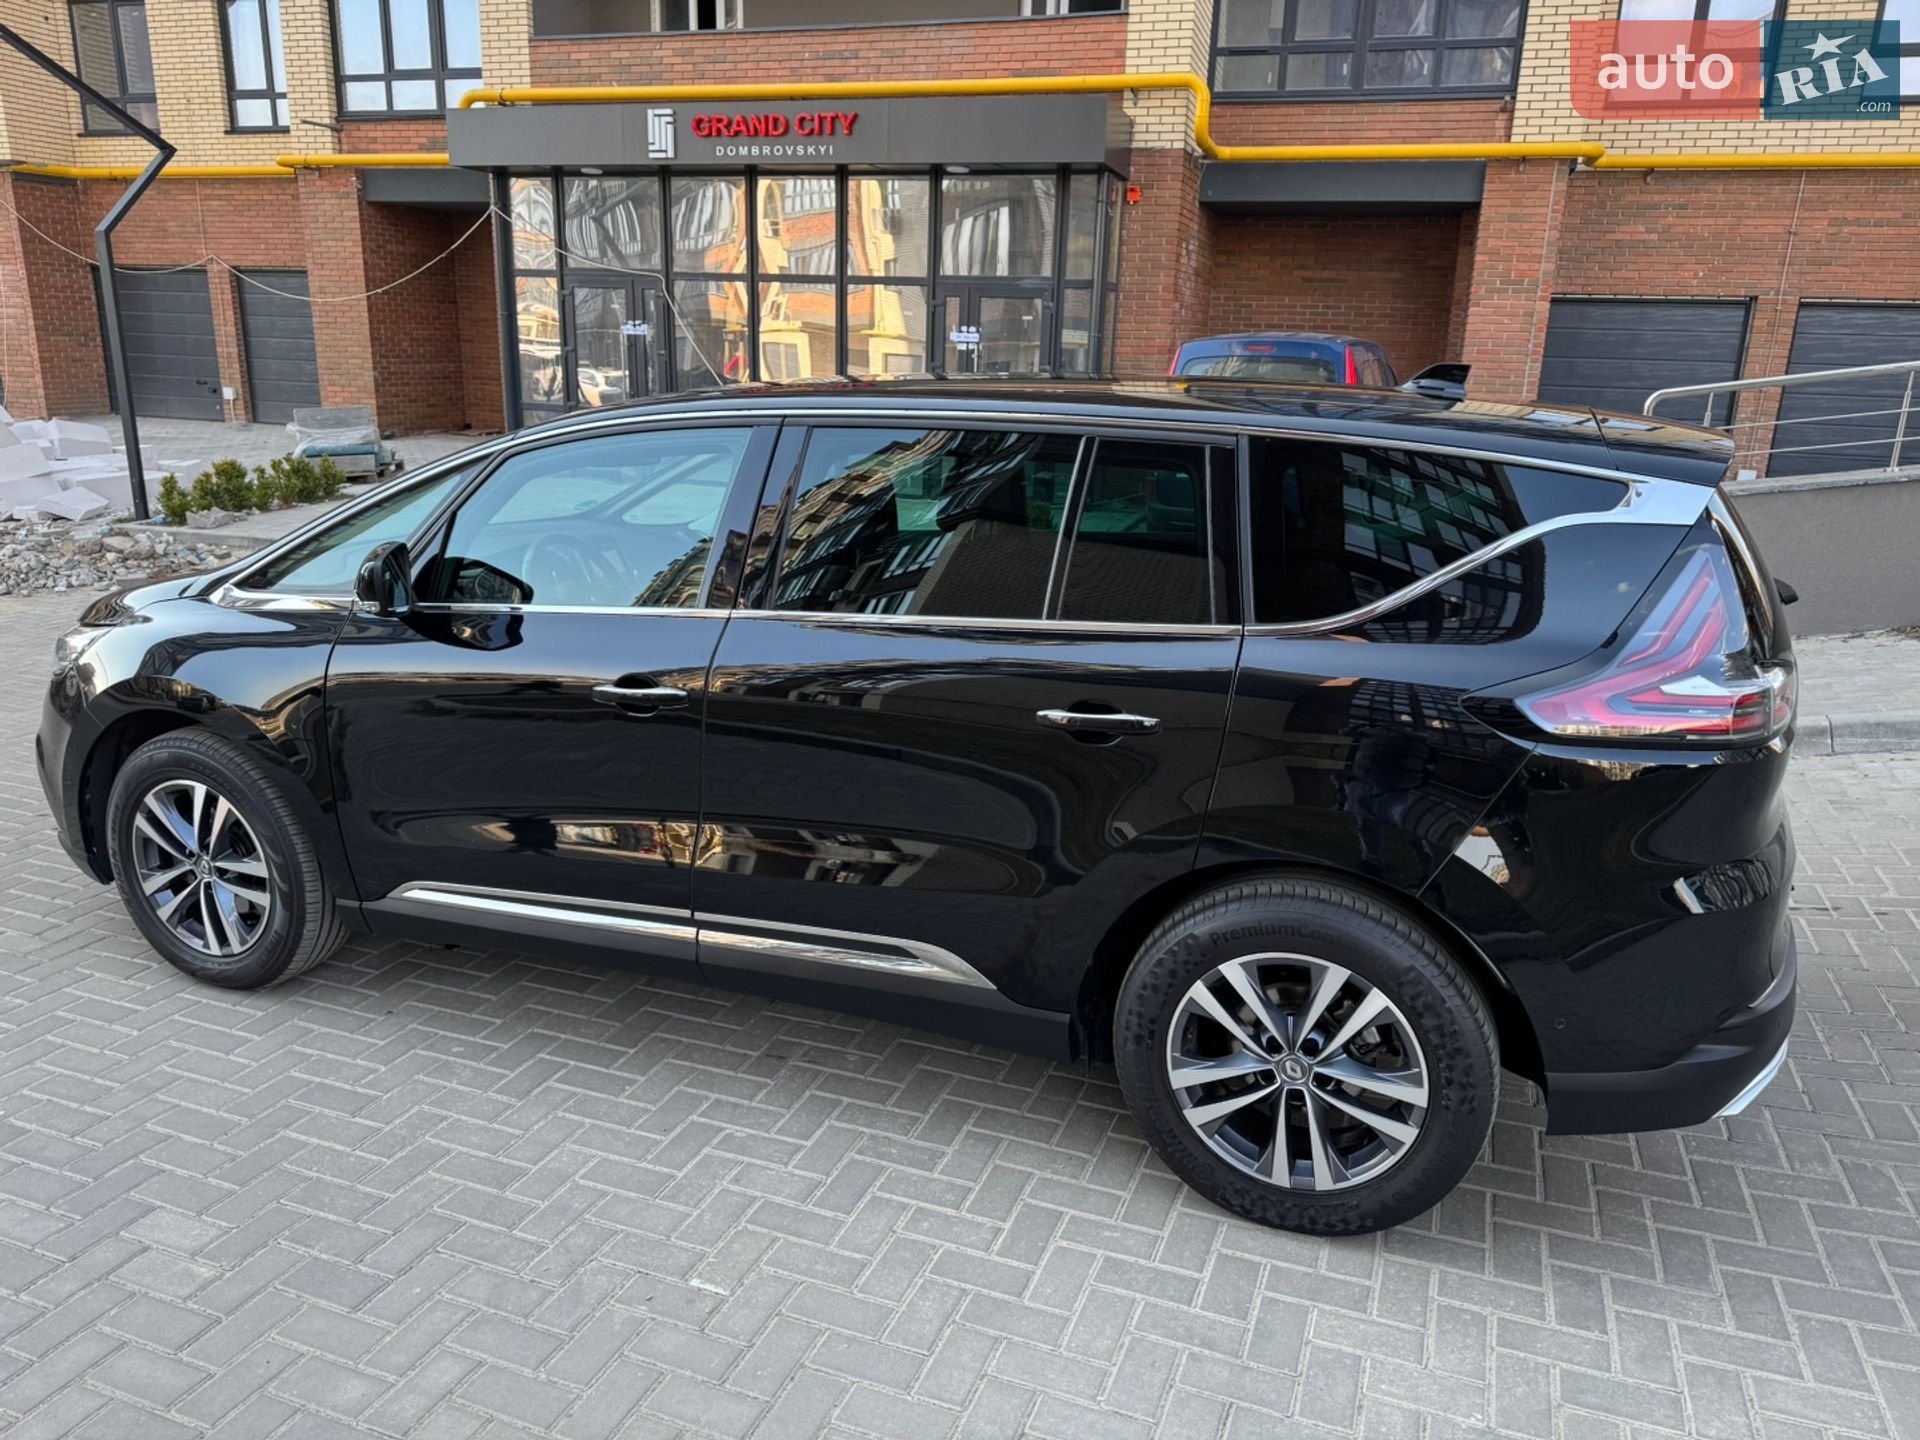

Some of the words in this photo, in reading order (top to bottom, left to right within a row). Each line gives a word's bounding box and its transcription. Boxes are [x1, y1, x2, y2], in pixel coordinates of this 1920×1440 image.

[691, 113, 789, 138] GRAND
[794, 111, 858, 136] CITY
[715, 145, 834, 157] DOMBROVSKYI
